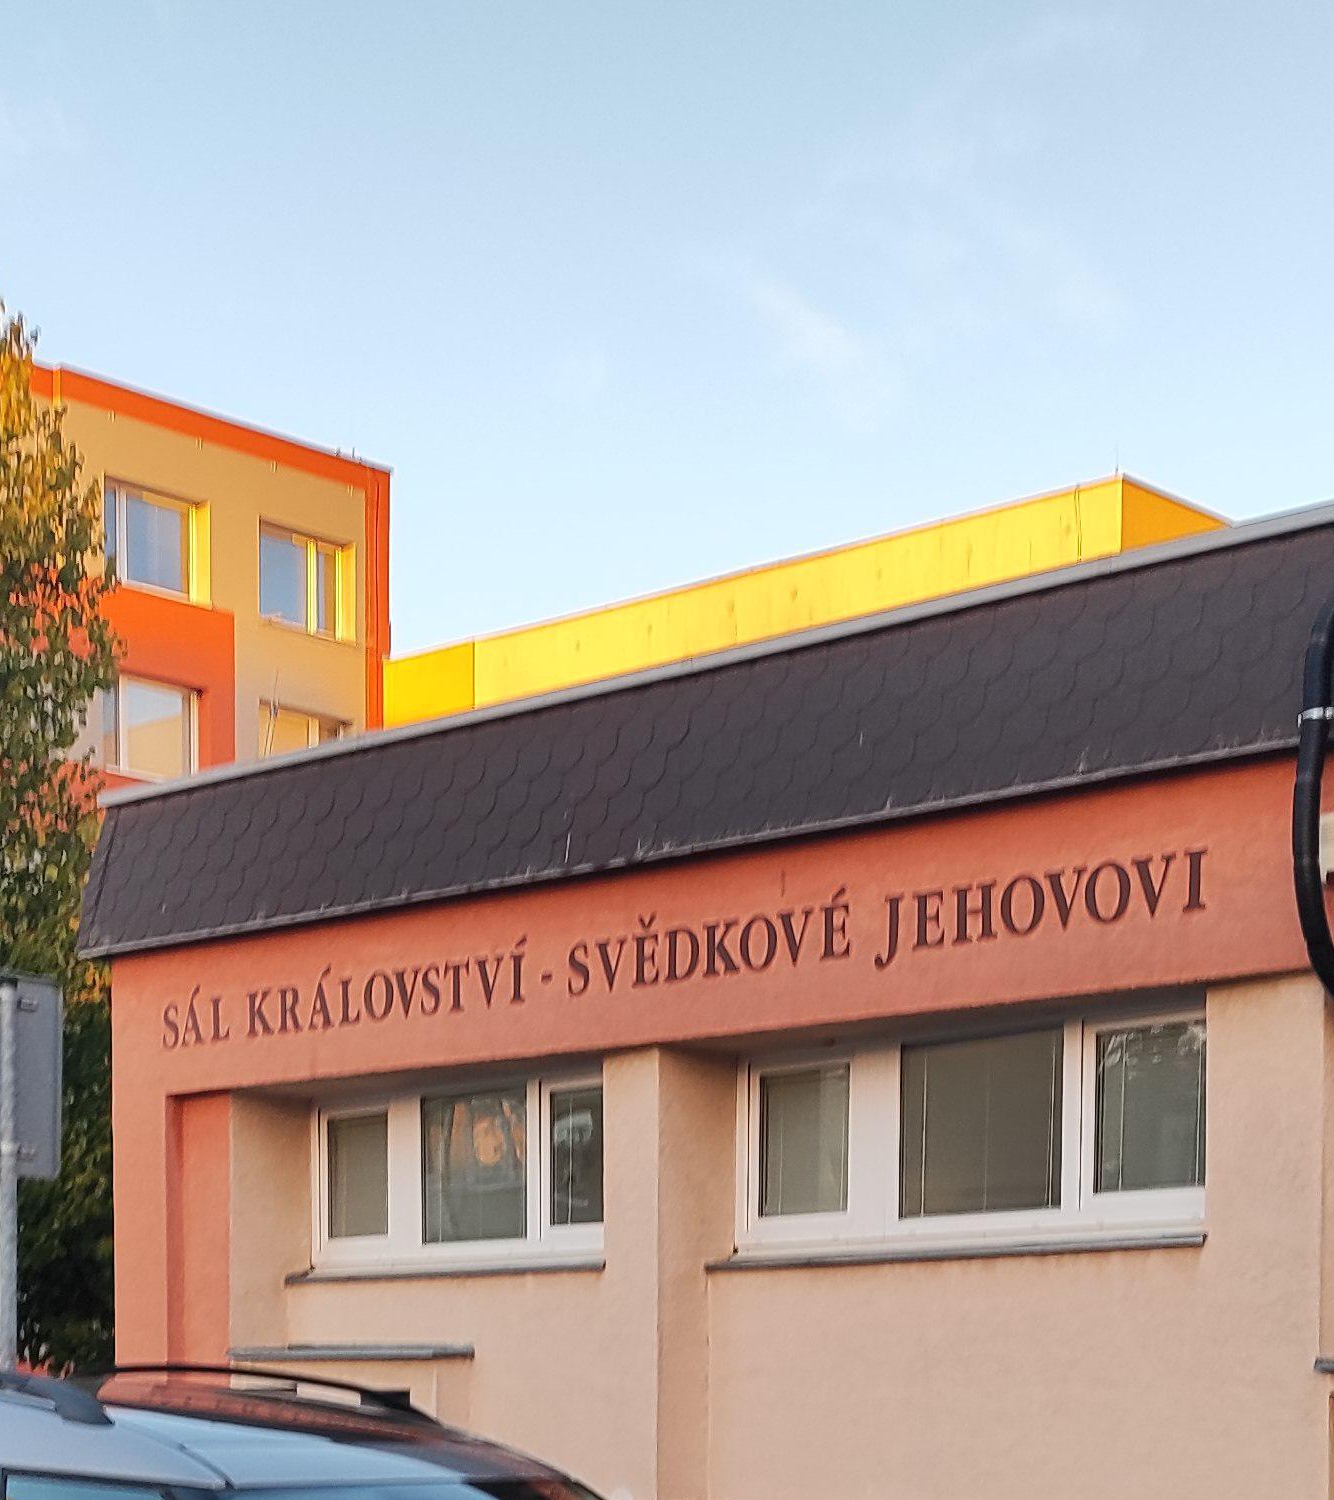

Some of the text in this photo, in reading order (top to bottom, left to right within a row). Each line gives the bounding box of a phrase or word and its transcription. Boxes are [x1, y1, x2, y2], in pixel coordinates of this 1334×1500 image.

[163, 984, 230, 1049] SÁL
[246, 934, 528, 1037] KRÁLOVSTVÍ
[568, 884, 851, 997] SVĚDKOVÉ
[874, 846, 1208, 969] JEHOVOVI
